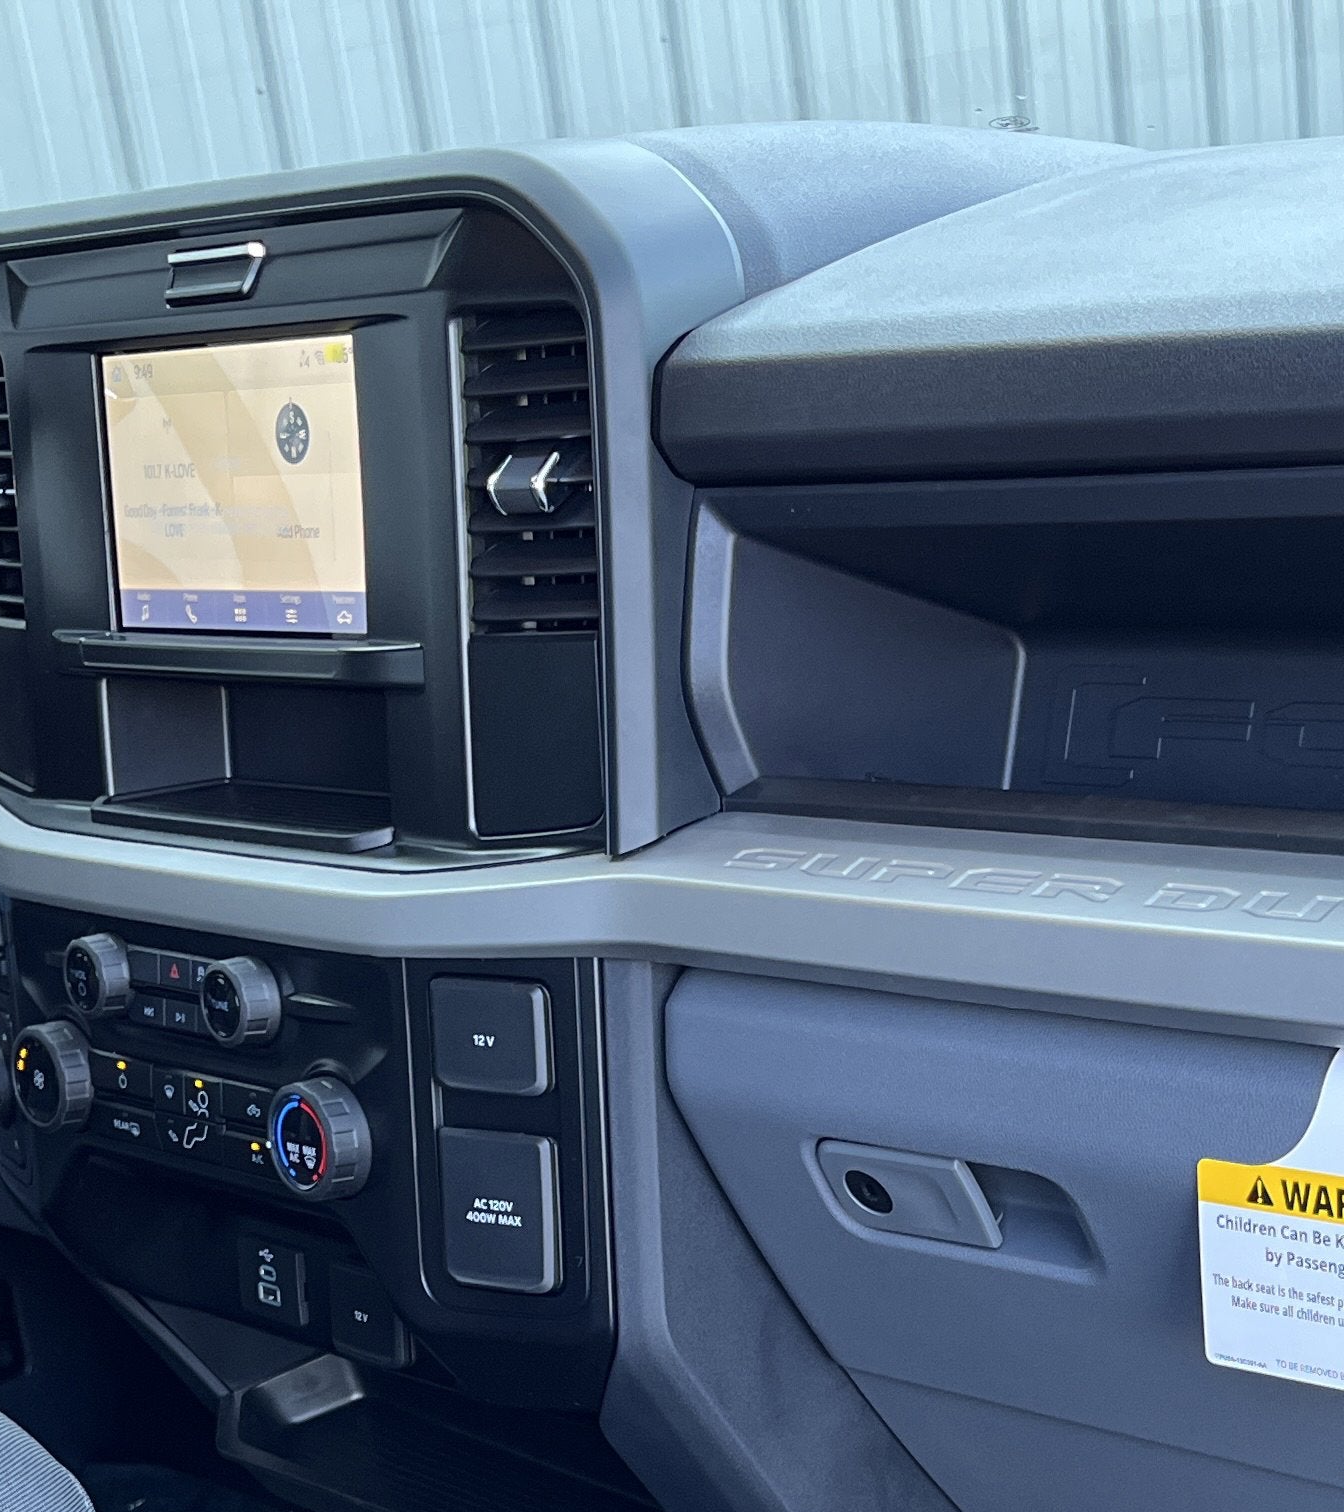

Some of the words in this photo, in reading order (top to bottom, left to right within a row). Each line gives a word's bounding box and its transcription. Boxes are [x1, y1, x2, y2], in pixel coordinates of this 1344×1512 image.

[722, 846, 1125, 904] SUPER
[465, 1211, 497, 1225] 400W
[498, 1213, 523, 1227] MAX
[473, 1198, 488, 1210] AC
[488, 1199, 513, 1213] 120V
[1216, 1213, 1277, 1238] Children
[1280, 1225, 1308, 1243] Can
[1312, 1230, 1331, 1247] Be
[1265, 1246, 1283, 1268] by
[1212, 1273, 1230, 1287] The
[1232, 1275, 1254, 1292] back
[1255, 1282, 1276, 1296] seat
[1277, 1284, 1286, 1298] is
[1288, 1287, 1304, 1301] the
[1306, 1291, 1335, 1307] safest
[1231, 1295, 1258, 1311] Make
[1259, 1301, 1280, 1316] sure
[1282, 1305, 1294, 1318] all
[1296, 1306, 1336, 1327] children
[1275, 1358, 1287, 1369] TO
[1289, 1362, 1298, 1372] BE
[1300, 1363, 1339, 1380] REMOVED
